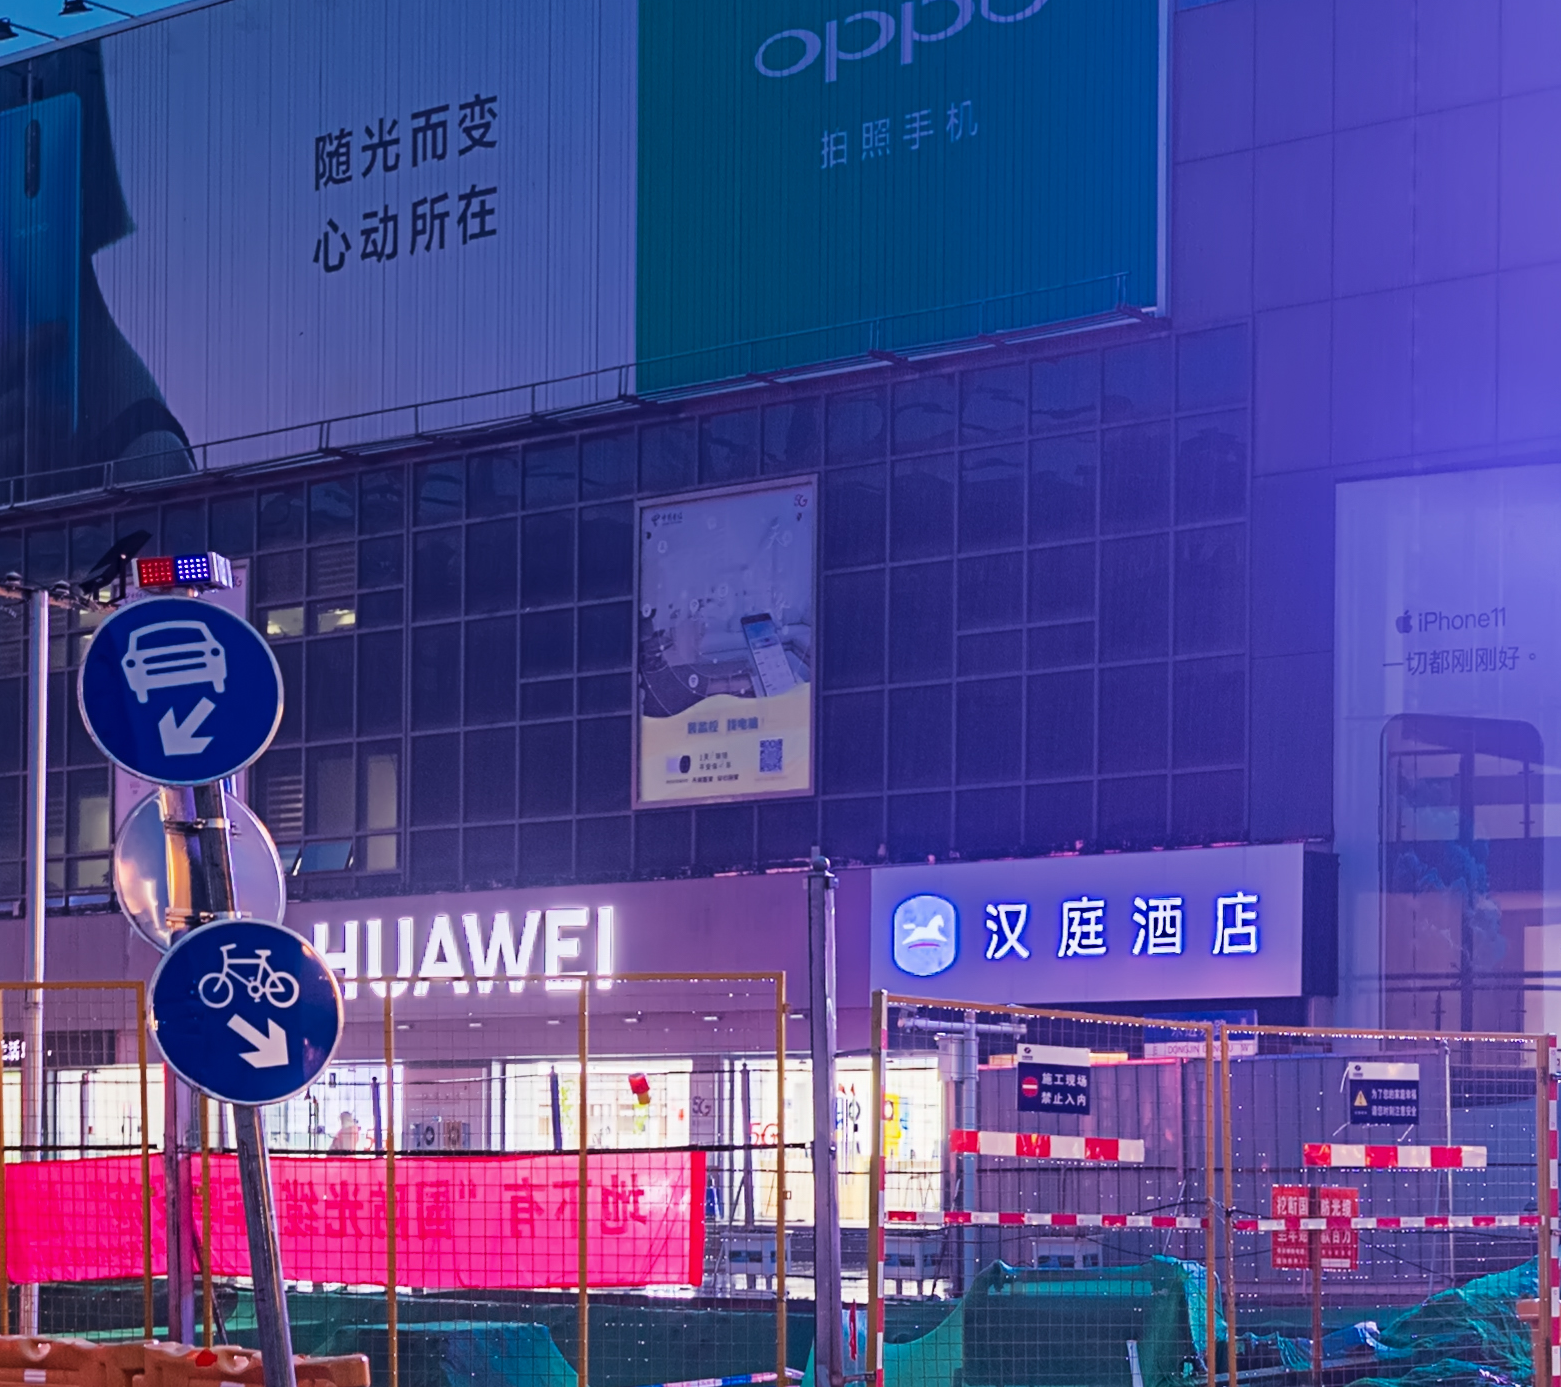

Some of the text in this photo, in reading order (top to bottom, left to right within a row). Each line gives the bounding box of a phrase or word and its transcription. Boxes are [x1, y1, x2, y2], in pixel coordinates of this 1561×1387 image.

[312, 93, 499, 192] 随光而变
[819, 101, 980, 170] 拍照手机
[311, 182, 499, 276] 心动所在
[313, 906, 615, 1000] HUAWEI
[985, 891, 1259, 960] 汉庭酒店
[1040, 1091, 1087, 1107] 禁止入内
[1041, 1072, 1088, 1087] 施工现场
